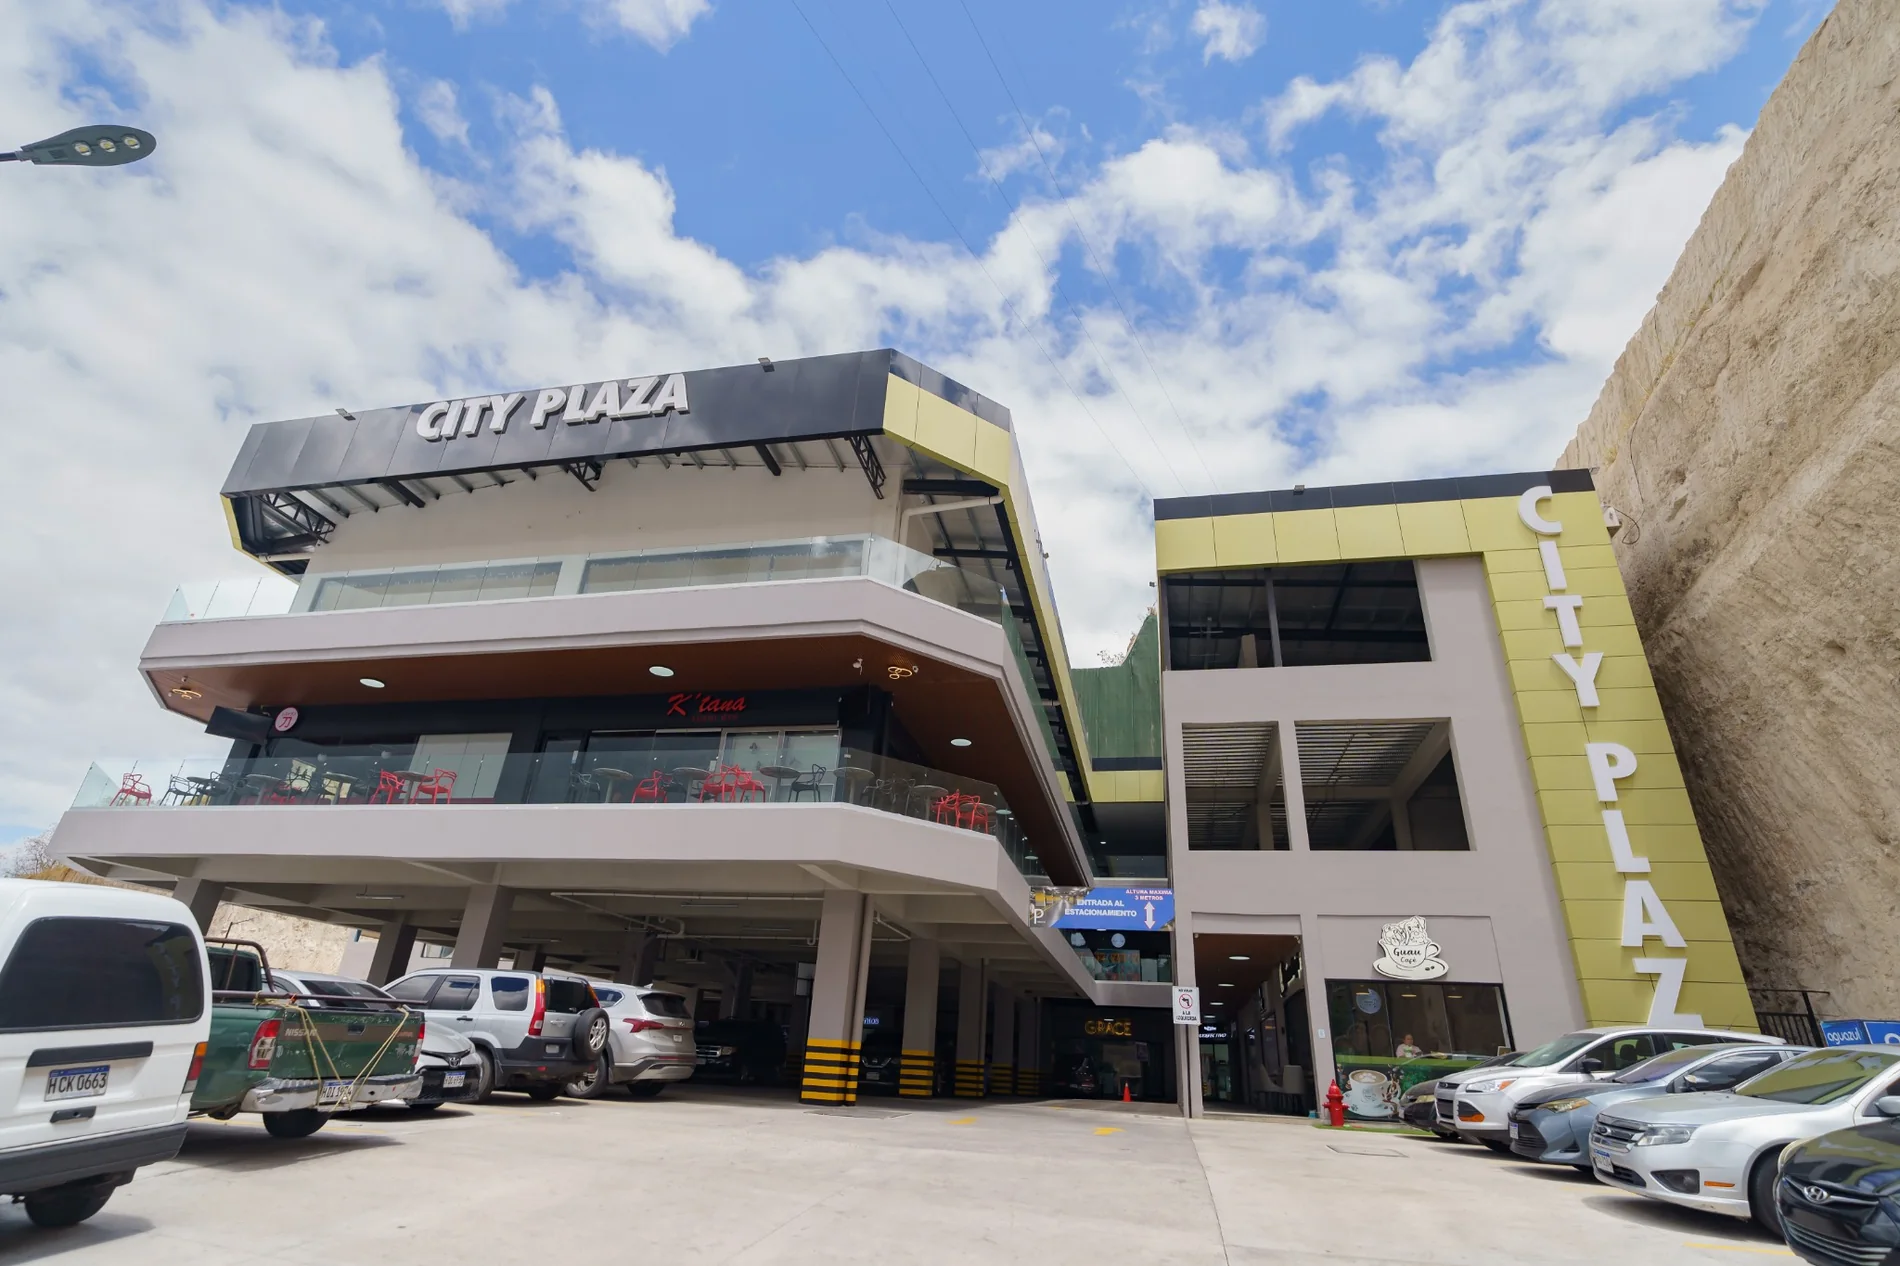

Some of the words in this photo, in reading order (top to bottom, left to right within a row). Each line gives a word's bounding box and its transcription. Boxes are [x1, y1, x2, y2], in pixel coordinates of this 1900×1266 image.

[416, 392, 525, 441] CITY
[530, 373, 690, 429] PLAZA
[1518, 486, 1604, 707] CITY
[1585, 743, 1704, 1028] PLAZ
[1076, 899, 1113, 907] ENTRADA
[1064, 908, 1137, 917] ESTACIONAMIENTO
[1393, 947, 1421, 957] Guau
[284, 1028, 318, 1037] NISSAN
[1084, 1020, 1132, 1036] GRACE
[1827, 1027, 1862, 1045] aguazul
[48, 1075, 75, 1094] HCK
[76, 1073, 107, 1091] 0663
